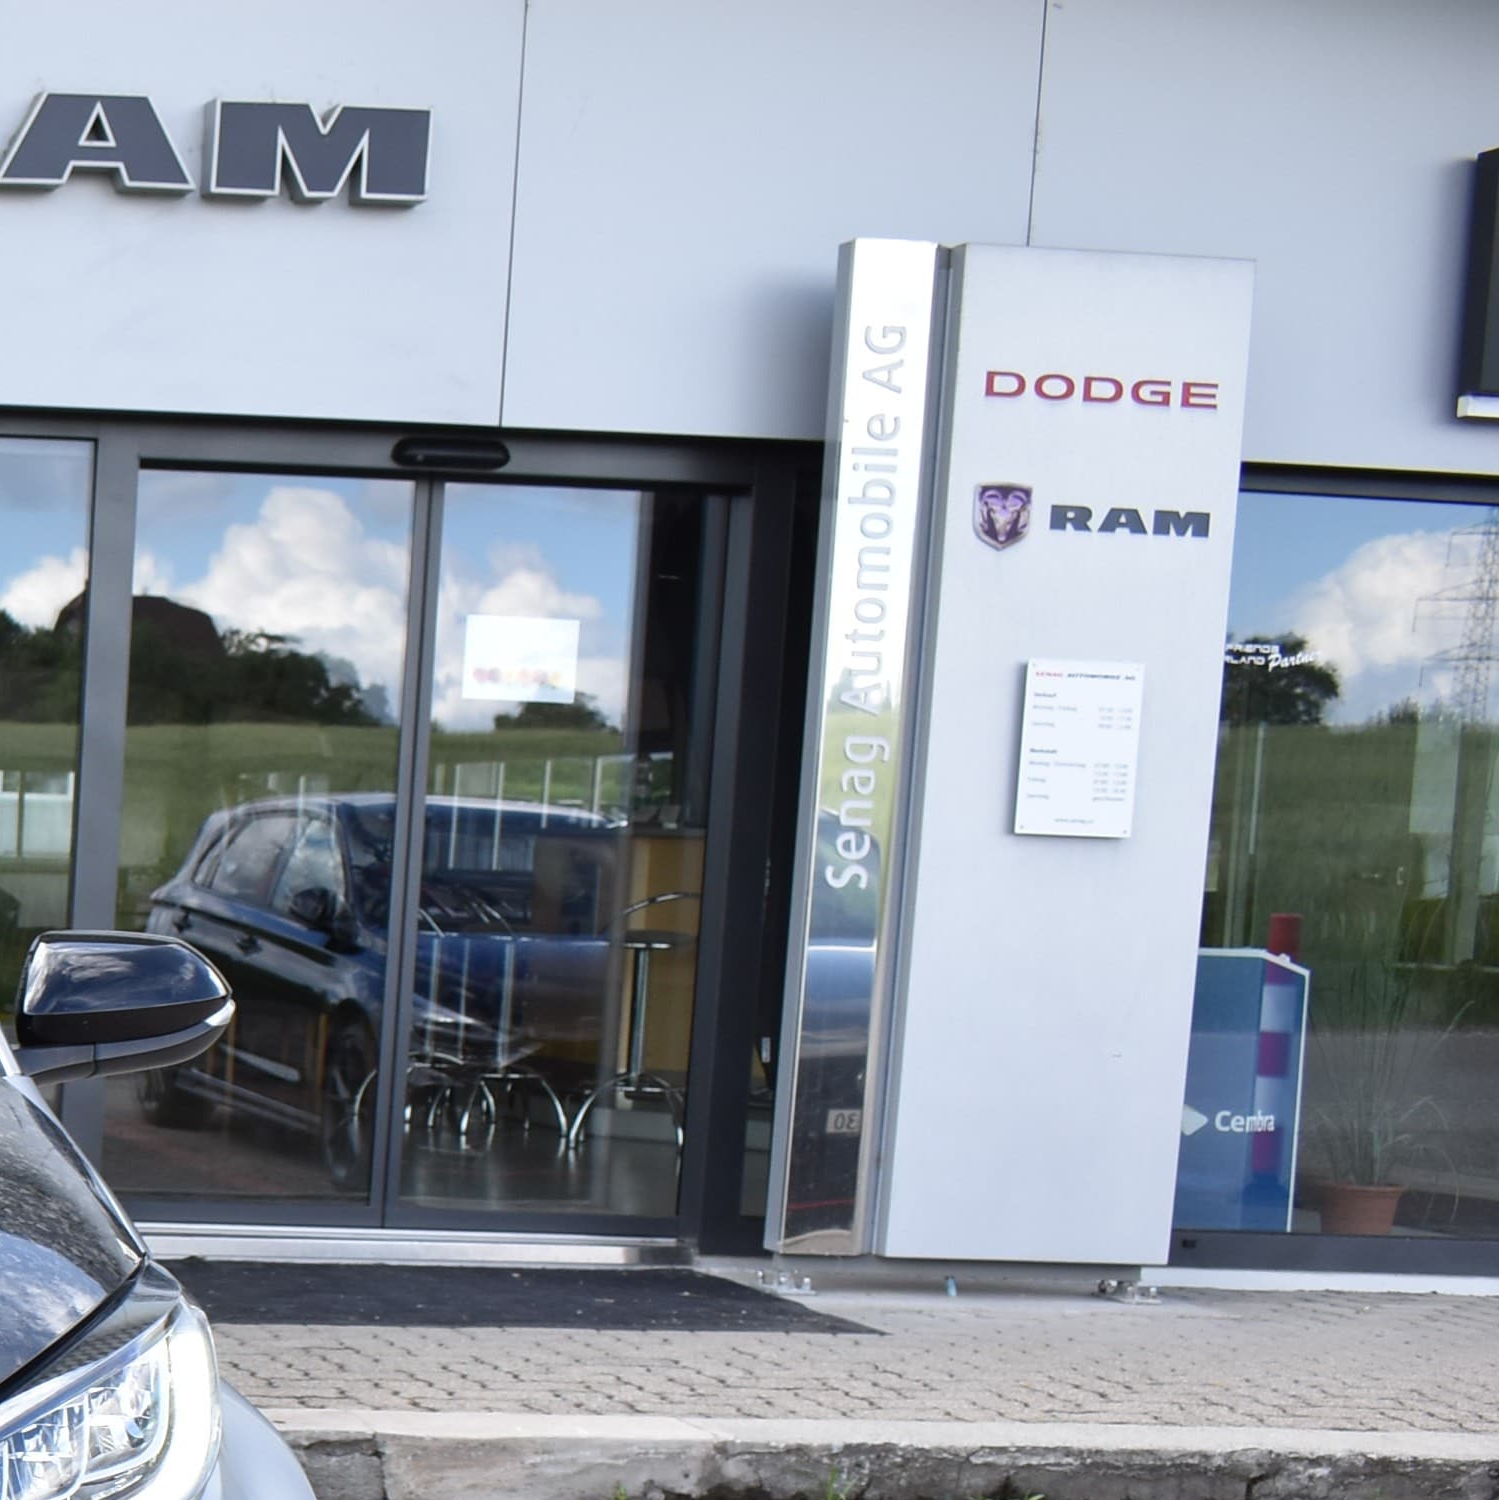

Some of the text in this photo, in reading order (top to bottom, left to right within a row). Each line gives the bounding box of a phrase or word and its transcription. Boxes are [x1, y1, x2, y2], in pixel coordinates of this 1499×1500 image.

[985, 370, 1219, 409] DODGE
[1050, 504, 1210, 538] RAM
[825, 324, 907, 890] Senag Automobile AG
[1214, 1109, 1275, 1133] Cembra
